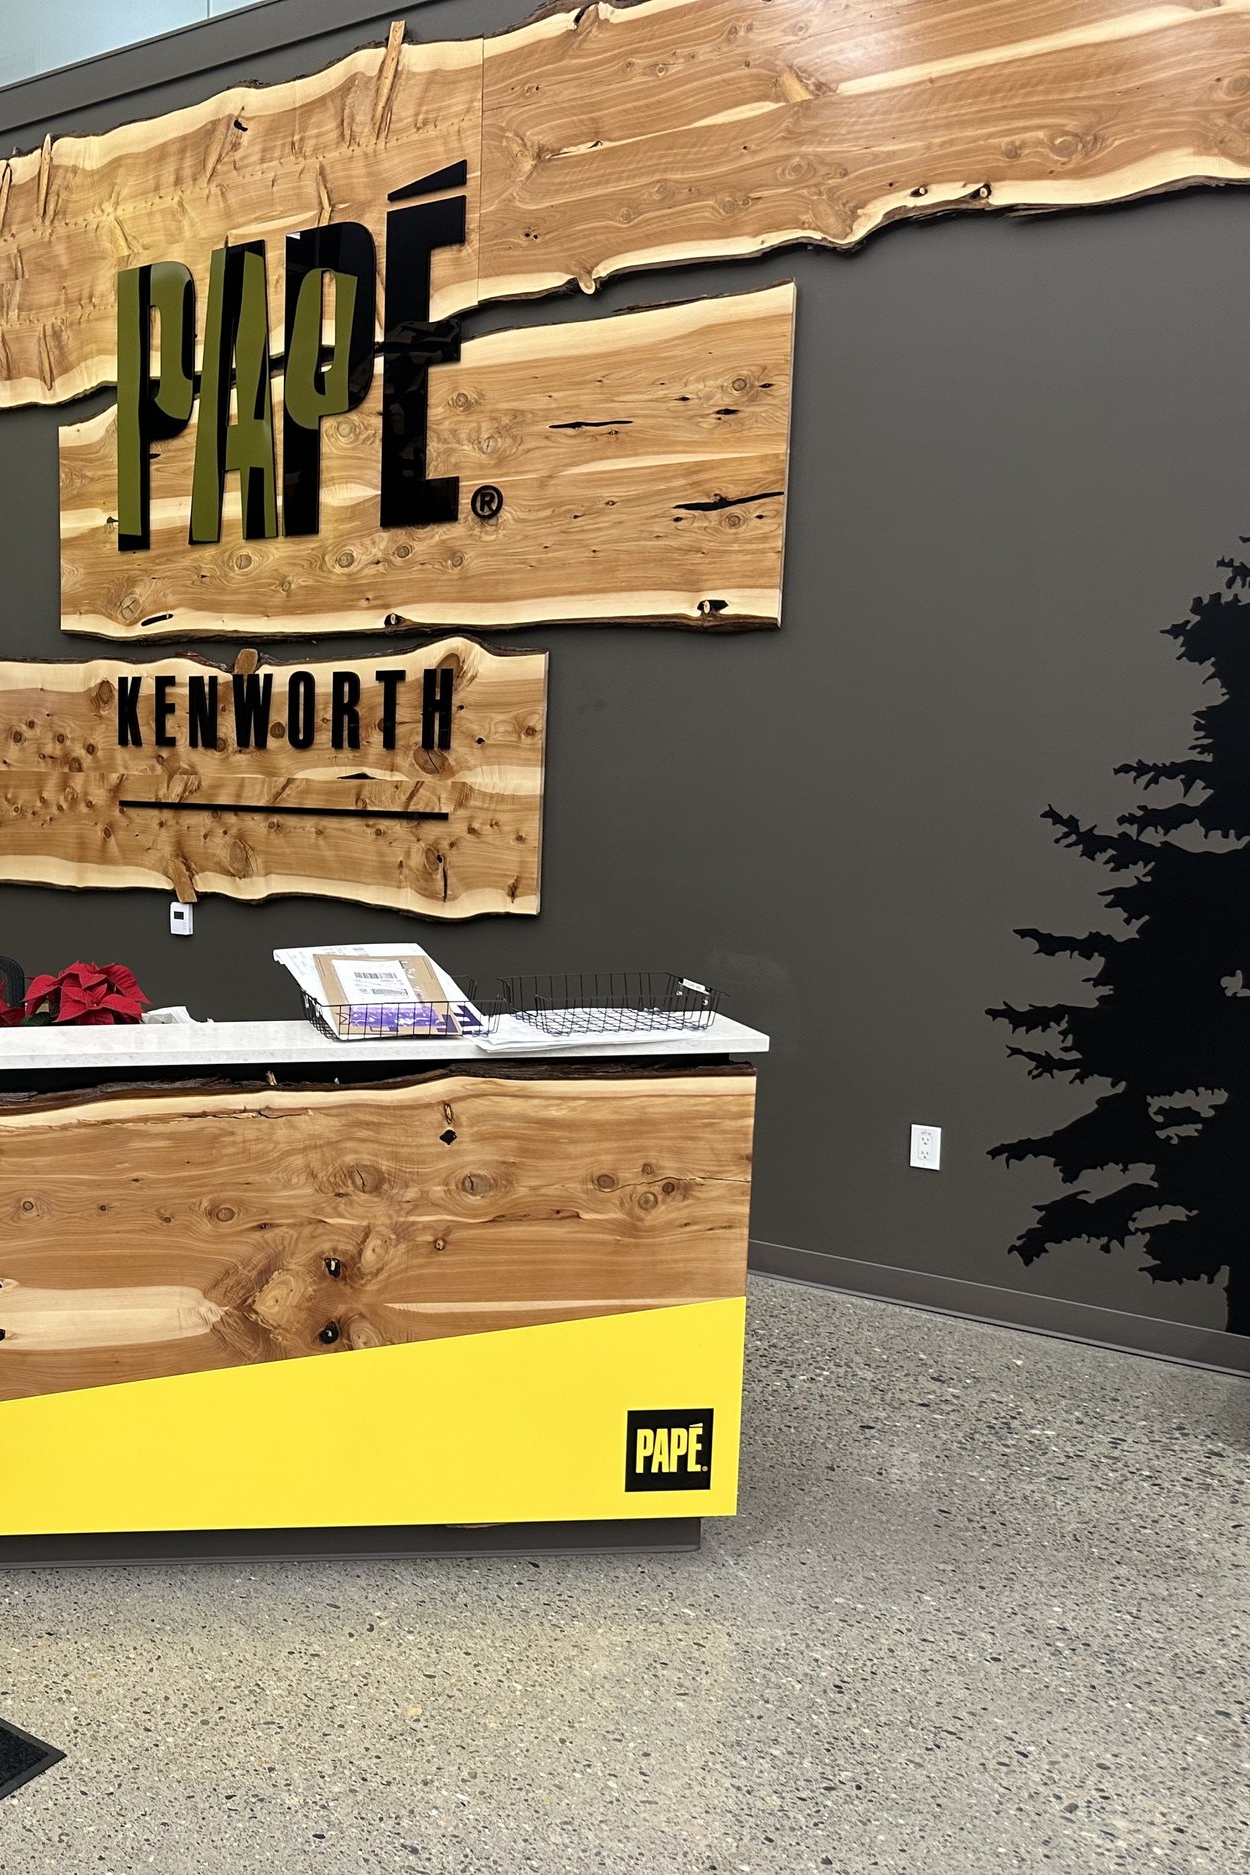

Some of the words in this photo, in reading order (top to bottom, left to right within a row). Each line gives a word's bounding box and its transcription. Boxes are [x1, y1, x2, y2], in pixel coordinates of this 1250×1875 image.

[117, 159, 468, 552] PAPÉ
[117, 668, 454, 750] KENWORTH
[635, 1422, 704, 1474] PAPÉ
